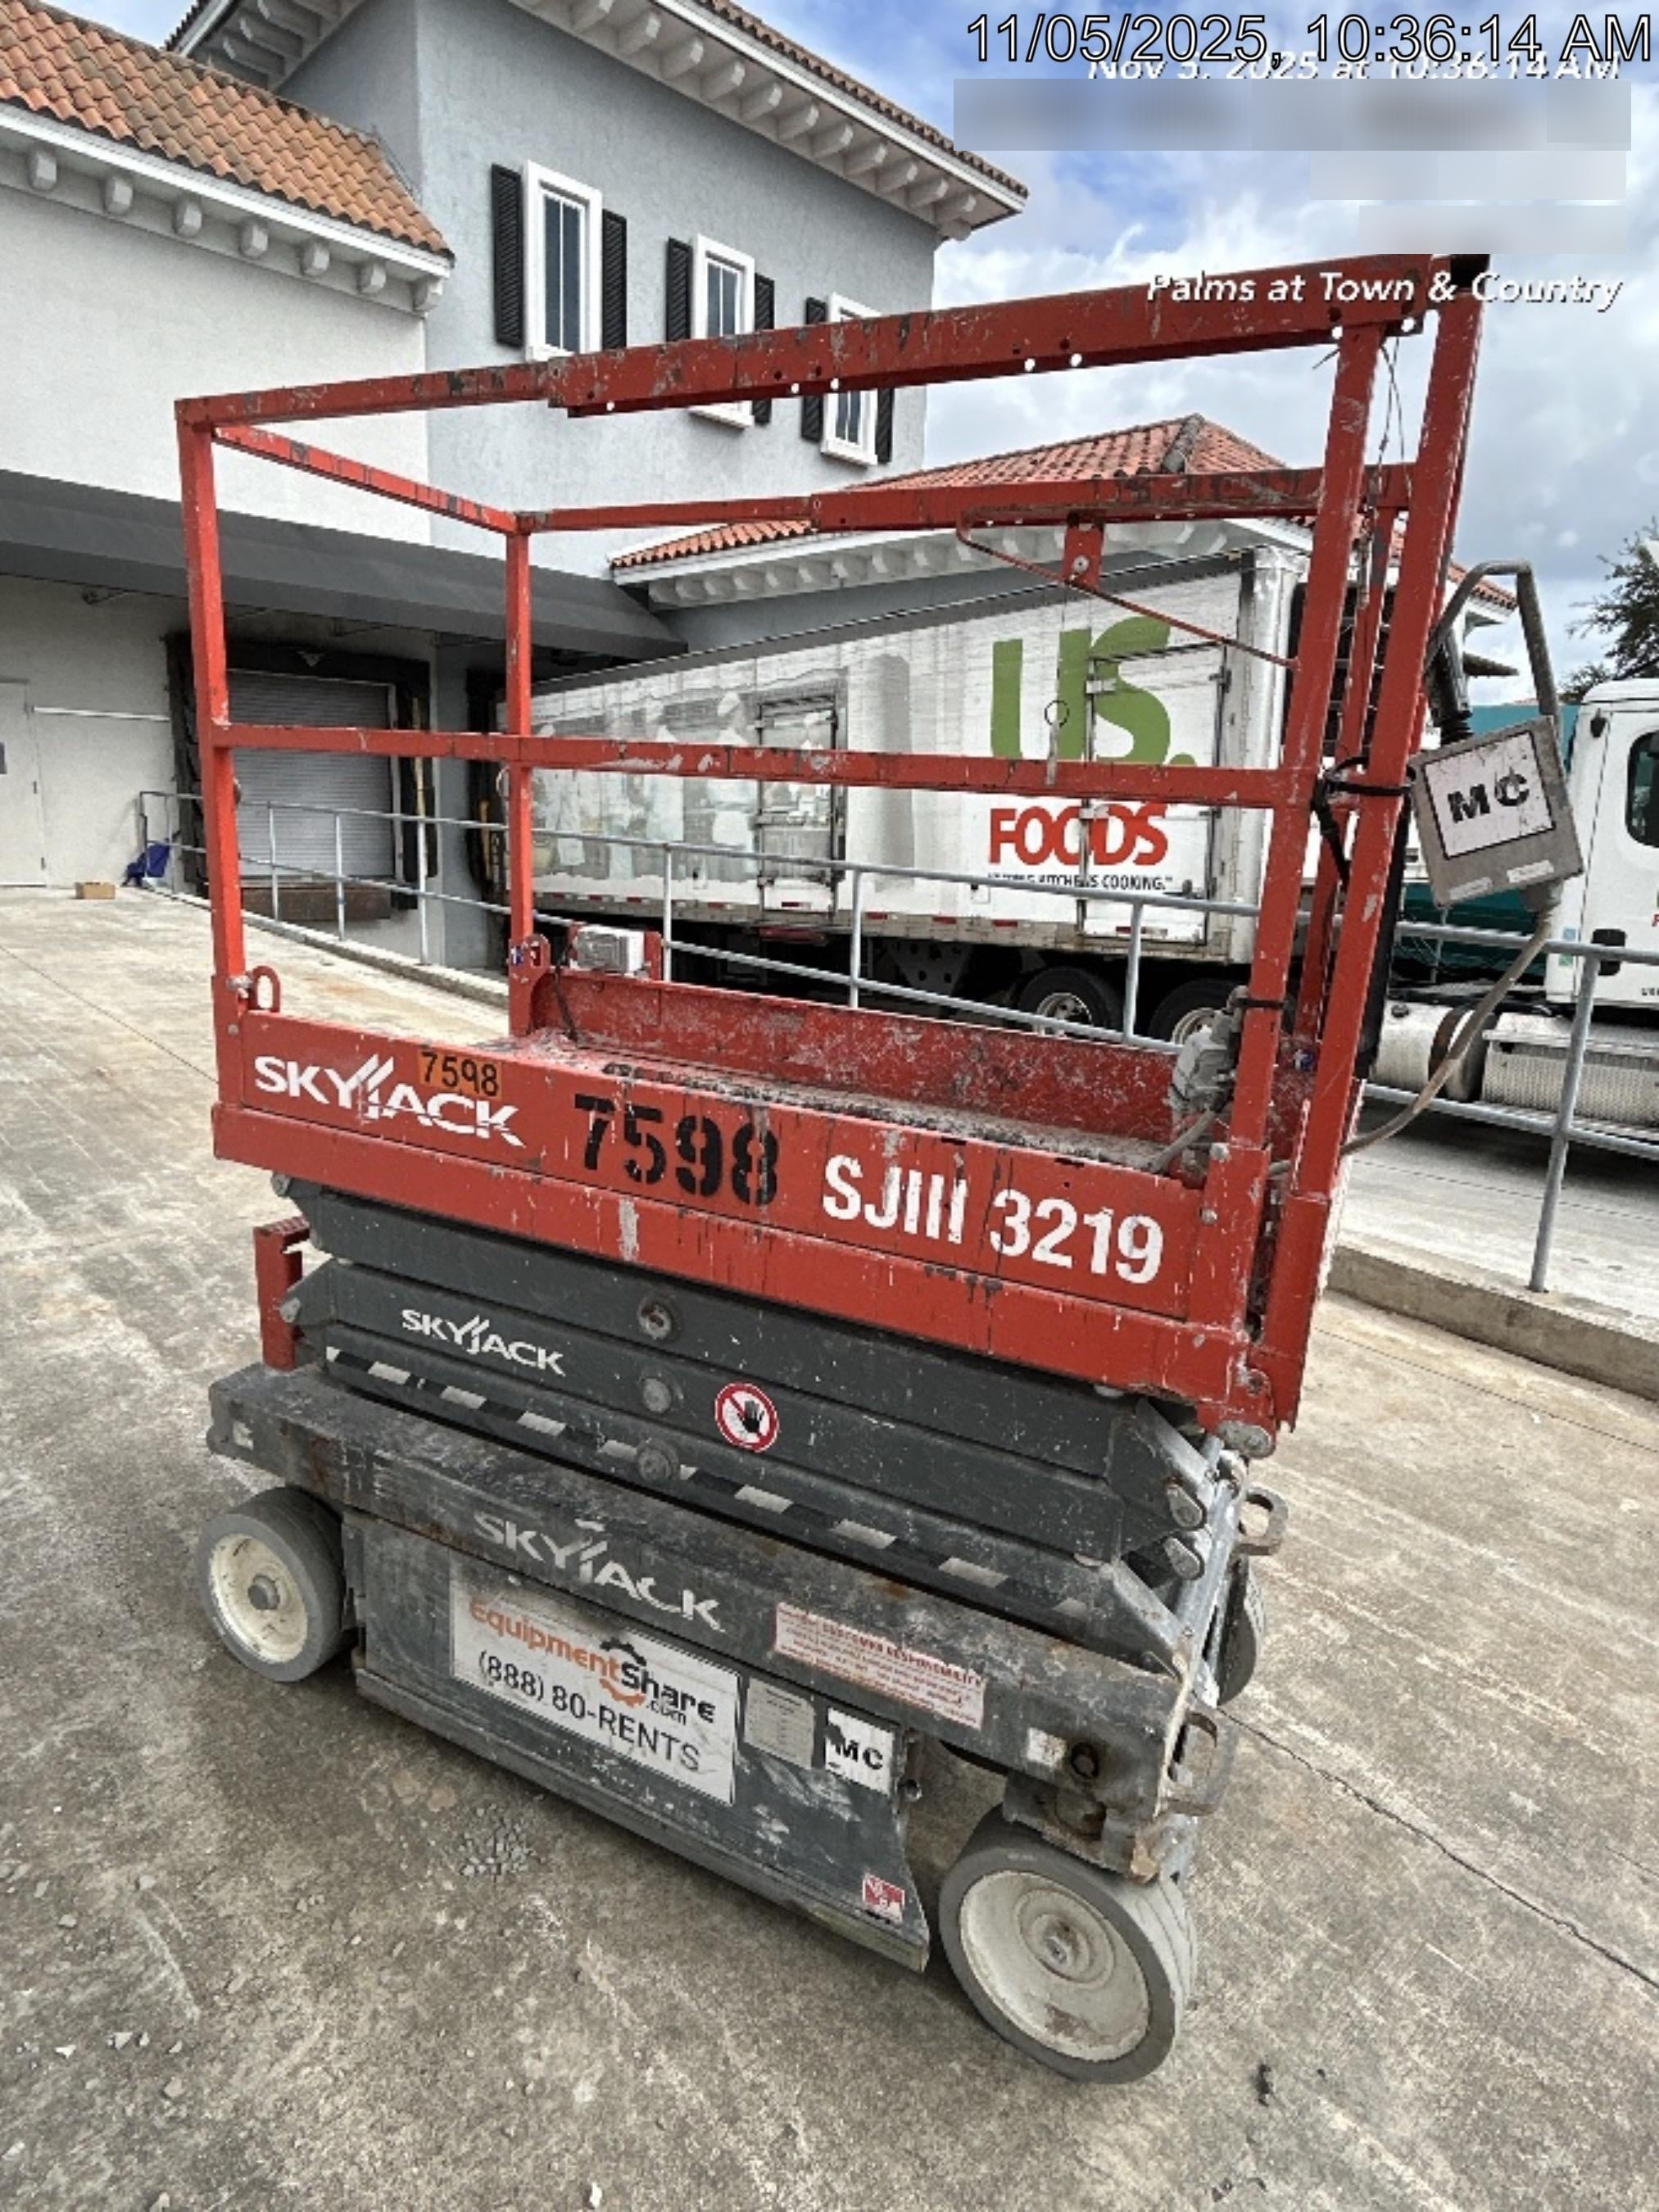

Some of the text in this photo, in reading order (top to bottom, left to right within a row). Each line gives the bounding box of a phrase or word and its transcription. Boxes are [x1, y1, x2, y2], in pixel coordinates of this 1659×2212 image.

[1448, 772, 1530, 823] MC
[988, 801, 1169, 867] FOODS
[254, 1054, 524, 1147] SKYJACK
[420, 1050, 501, 1097] 7598
[573, 1092, 780, 1207] 7598
[989, 1187, 1164, 1285] 3219
[401, 1309, 566, 1377] SKYJACK
[478, 1650, 545, 1702] (888)
[552, 1685, 701, 1772] 80-RENTS
[835, 1738, 884, 1770] MC
